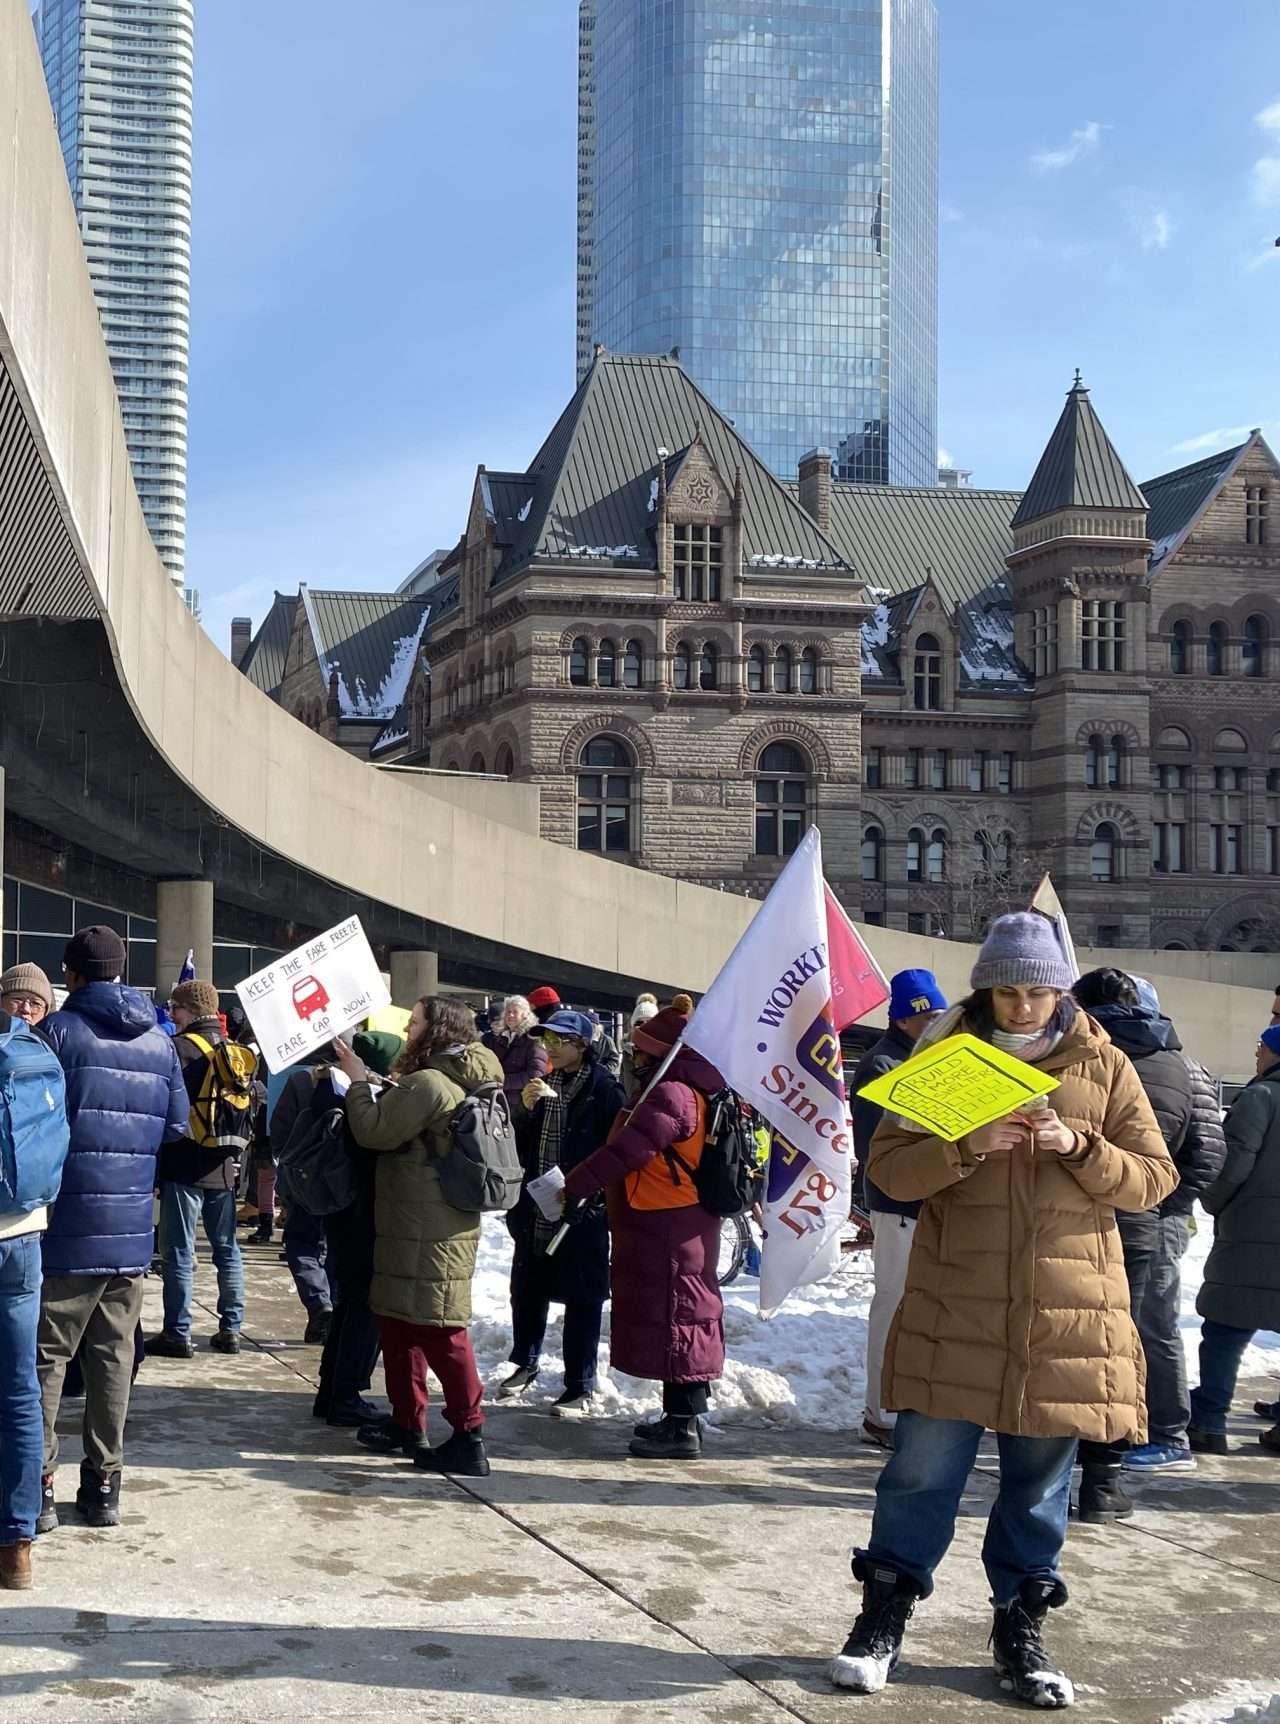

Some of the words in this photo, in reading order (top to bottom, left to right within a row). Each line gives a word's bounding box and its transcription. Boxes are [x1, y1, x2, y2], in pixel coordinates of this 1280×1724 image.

[246, 972, 275, 998] KEEP
[280, 957, 303, 977] THE
[306, 941, 327, 961] FARE
[329, 920, 359, 943] FREEZE
[757, 943, 827, 1028] WORKI
[276, 1032, 307, 1059] FARE
[312, 1016, 331, 1033] CAP
[343, 991, 372, 1015] NOW!
[760, 1064, 850, 1154] Since
[905, 1058, 962, 1090] BUILD
[928, 1065, 976, 1092] MORE
